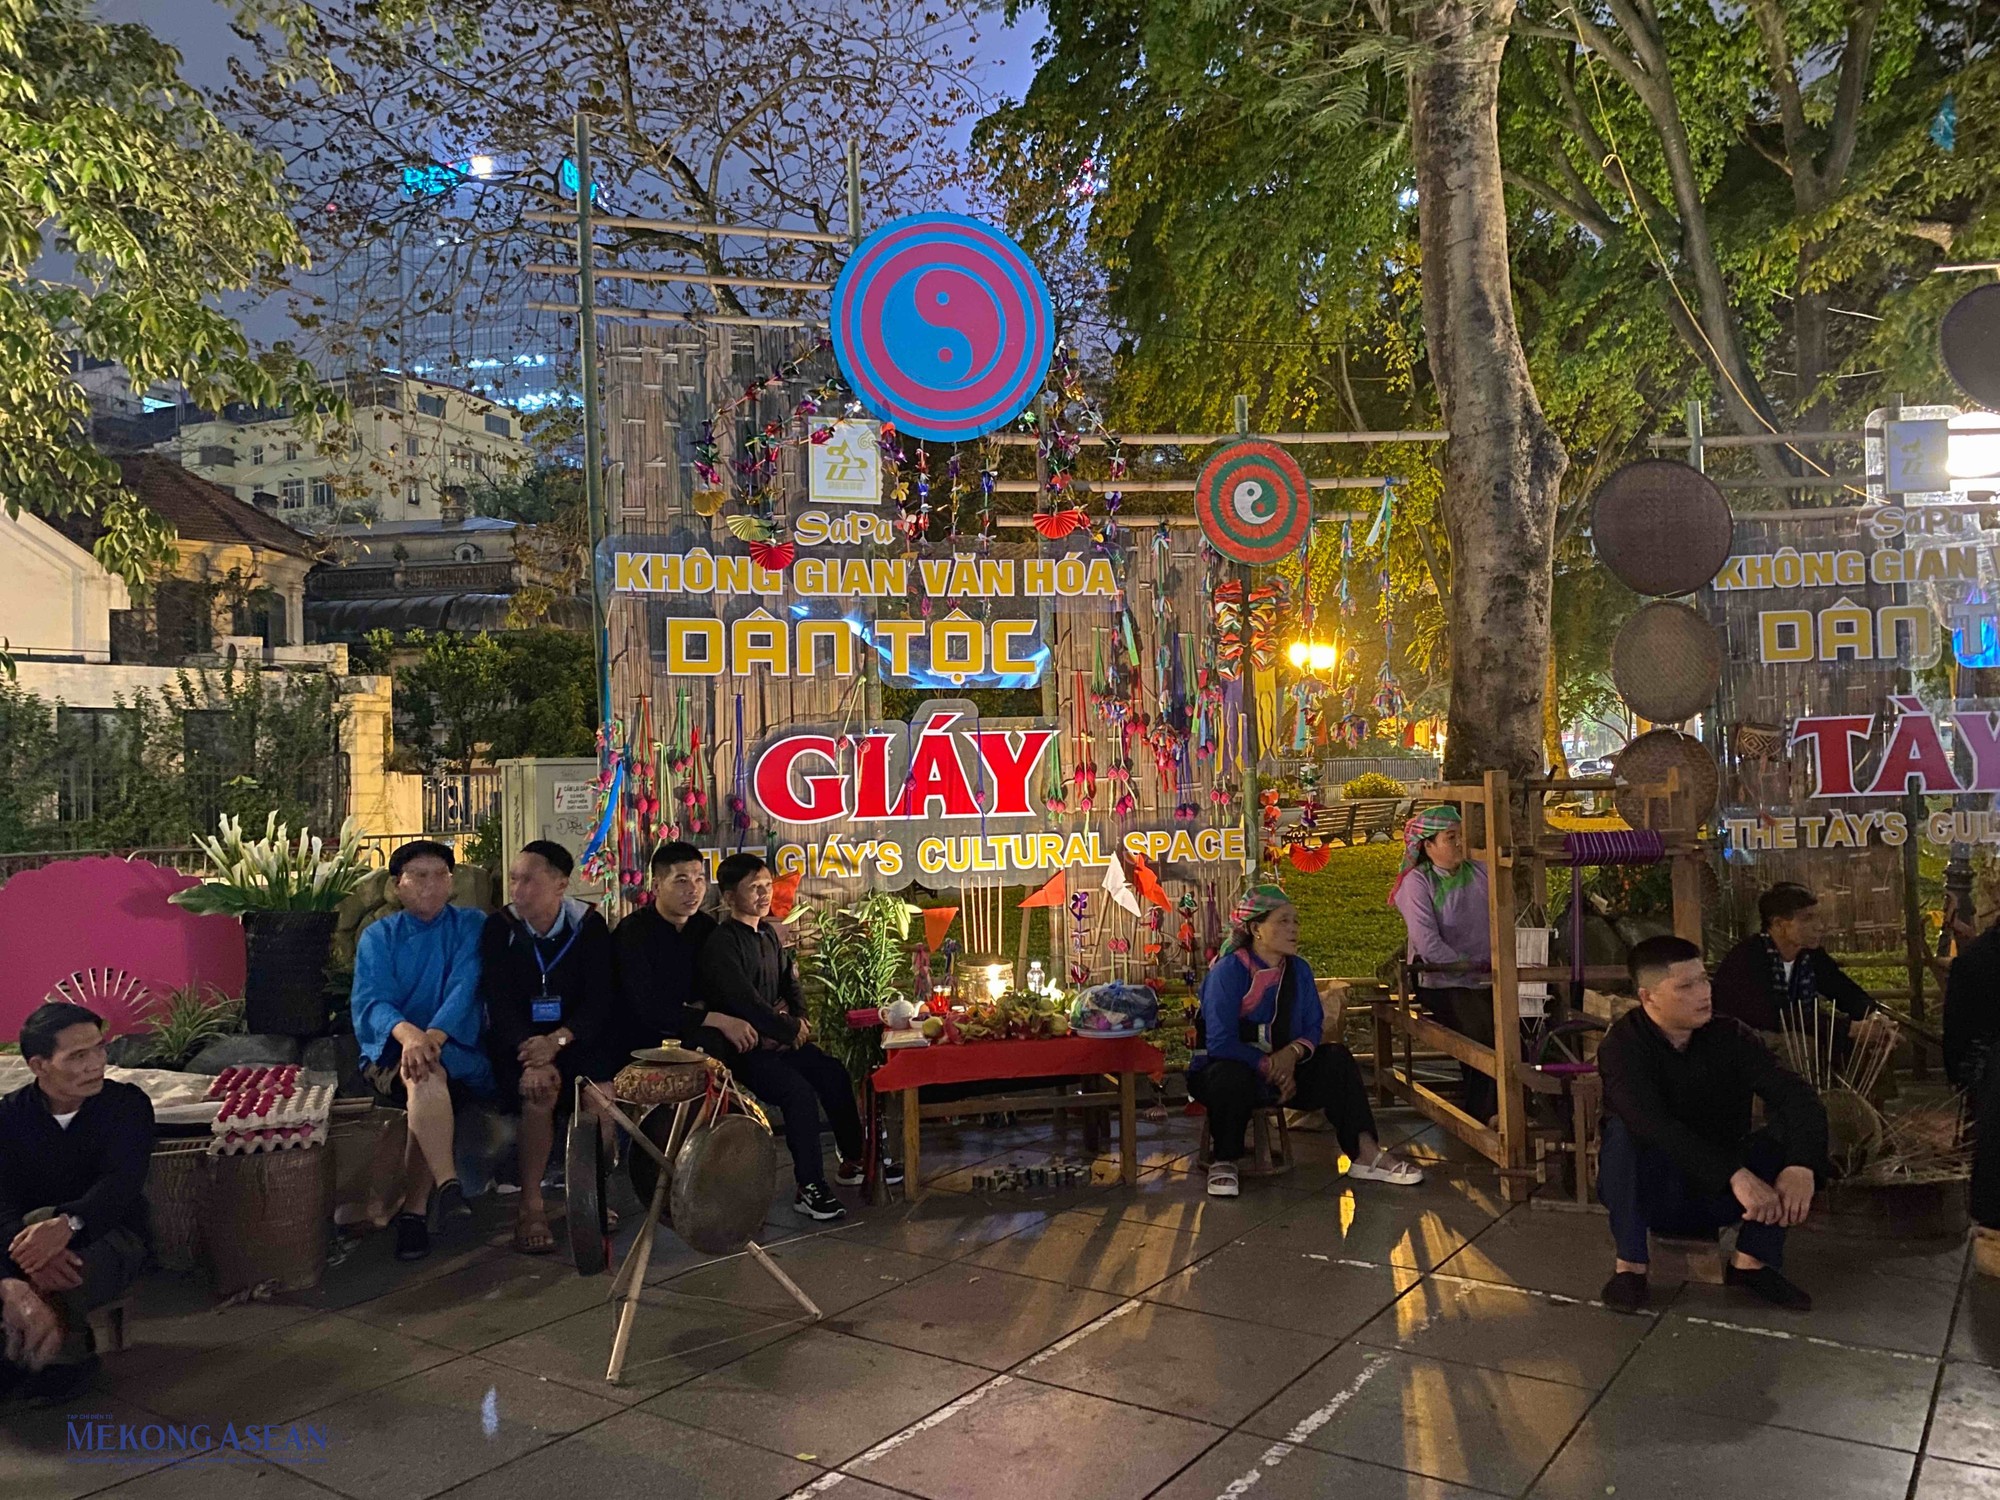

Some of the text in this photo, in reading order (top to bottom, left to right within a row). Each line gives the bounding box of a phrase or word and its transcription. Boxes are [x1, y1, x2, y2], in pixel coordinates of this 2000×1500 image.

[794, 510, 896, 546] SaPa
[615, 547, 1121, 597] KHÔNG GIAN VĂN HÓA
[1713, 547, 1866, 591] KHÔNG
[1871, 548, 1978, 584] GIAN
[666, 606, 1038, 685] DÂN TỘC
[753, 712, 1062, 825] GIÁY
[775, 834, 903, 879] GIÁY'S
[917, 828, 1111, 874] CULTURAL
[1124, 828, 1246, 863] SPACE
[1727, 815, 1798, 849] THE
[1801, 809, 1908, 848] TÀY'S
